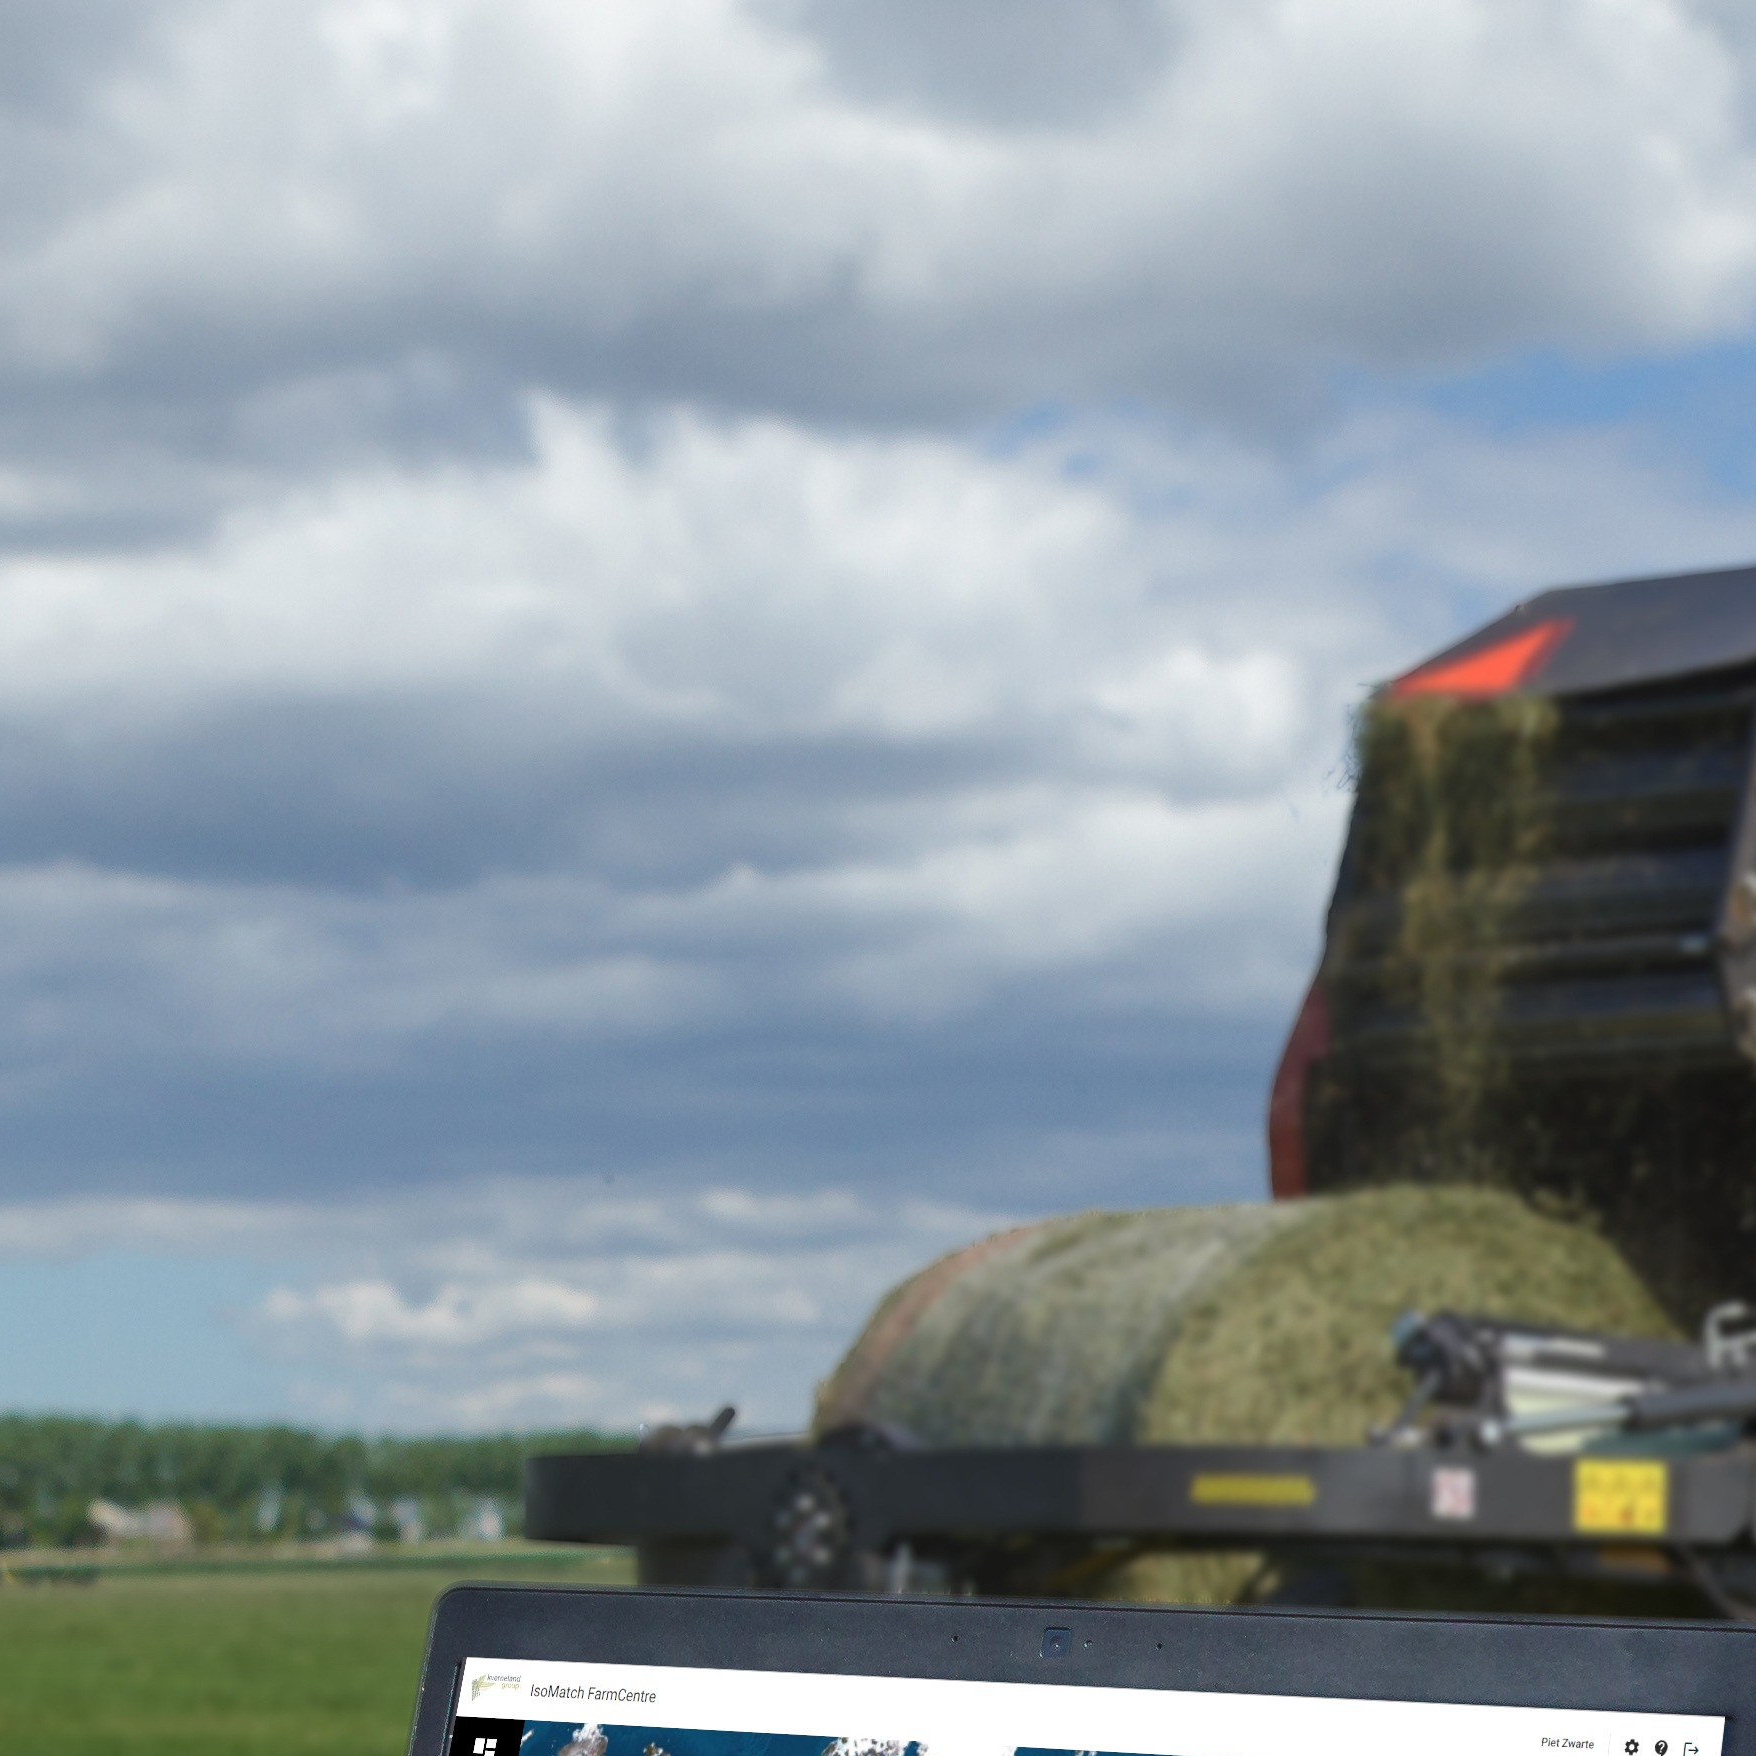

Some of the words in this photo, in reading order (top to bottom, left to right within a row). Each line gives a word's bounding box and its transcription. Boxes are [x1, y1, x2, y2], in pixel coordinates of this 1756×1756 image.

[501, 1682, 521, 1691] group
[530, 1683, 584, 1699] IsoMatch
[587, 1686, 656, 1703] FarmCentre
[1541, 1737, 1560, 1747] Piet
[1561, 1738, 1594, 1749] Zwarte
